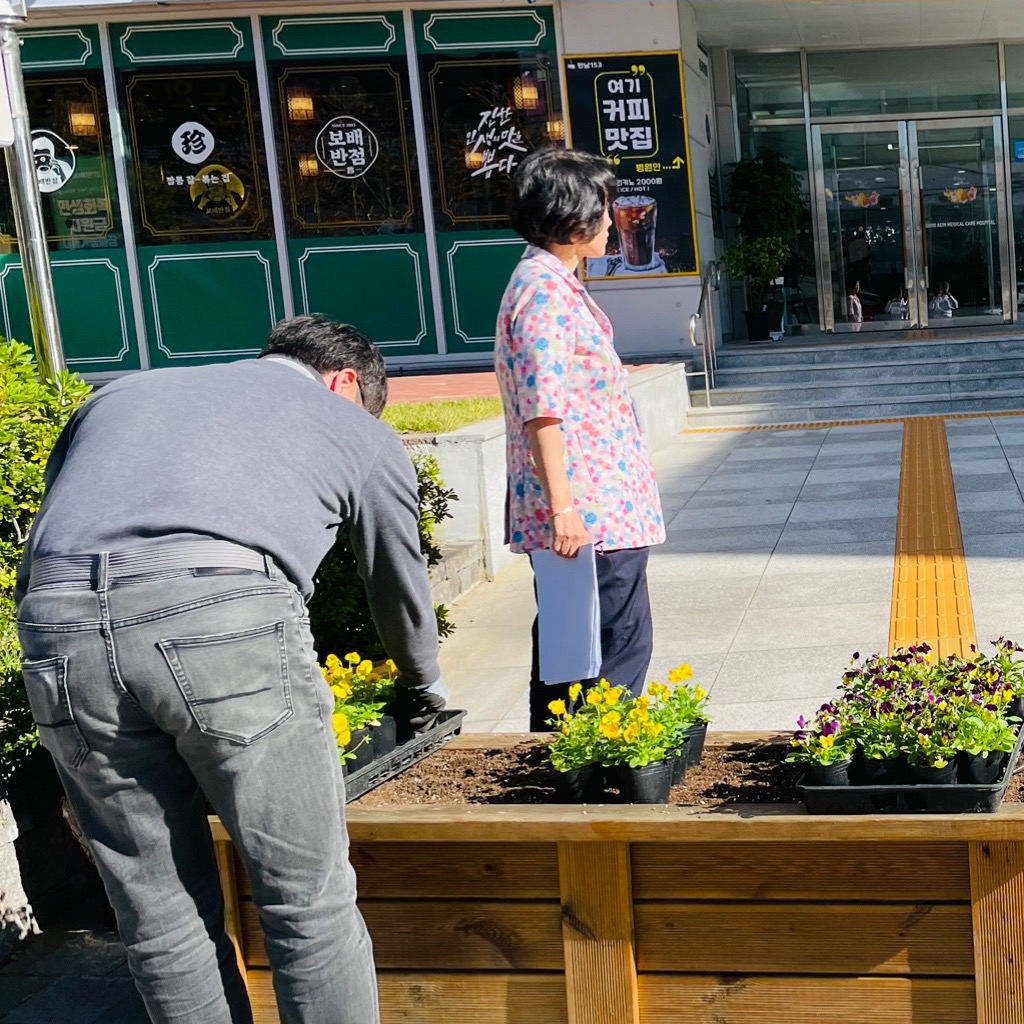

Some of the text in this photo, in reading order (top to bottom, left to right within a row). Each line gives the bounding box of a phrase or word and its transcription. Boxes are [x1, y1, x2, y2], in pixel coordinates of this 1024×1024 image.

[607, 78, 641, 94] 여기
[602, 98, 650, 122] 커피
[328, 128, 364, 146] 보배
[605, 127, 653, 151] 맛집
[330, 147, 366, 166] 반점
[635, 162, 661, 172] 병원안
[636, 177, 663, 186] 2000원
